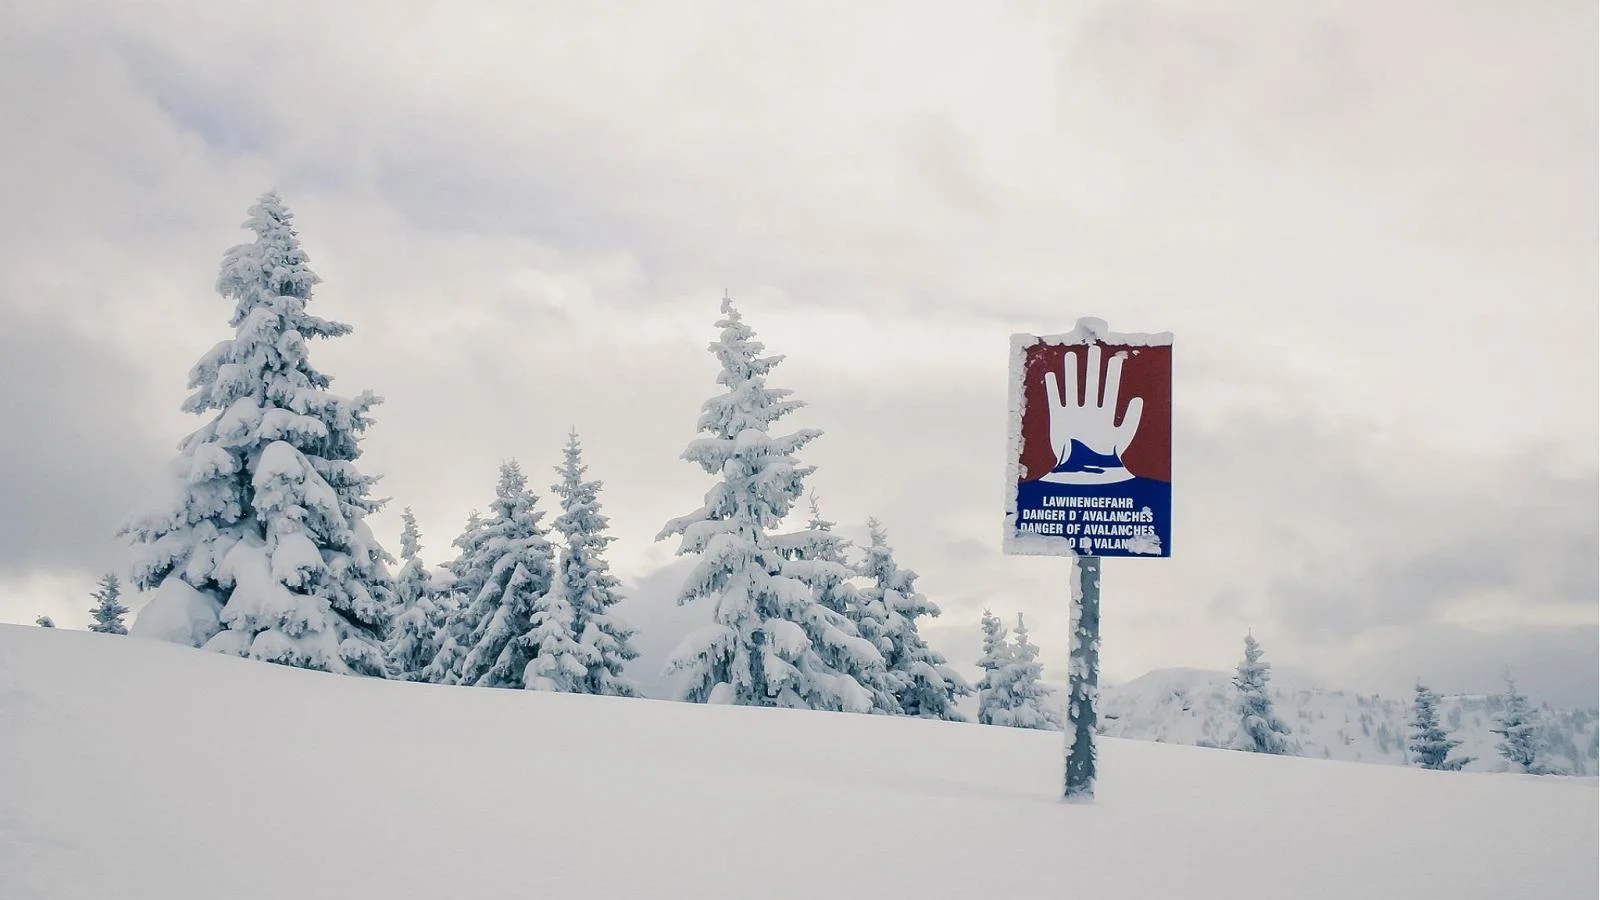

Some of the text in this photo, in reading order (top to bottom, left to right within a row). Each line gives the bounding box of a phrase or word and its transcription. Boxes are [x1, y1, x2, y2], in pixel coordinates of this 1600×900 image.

[1043, 496, 1133, 508] LAWINENGEFAHR
[1023, 509, 1065, 520] DANGER
[1021, 523, 1155, 536] DANGER OF AVALANCHES
